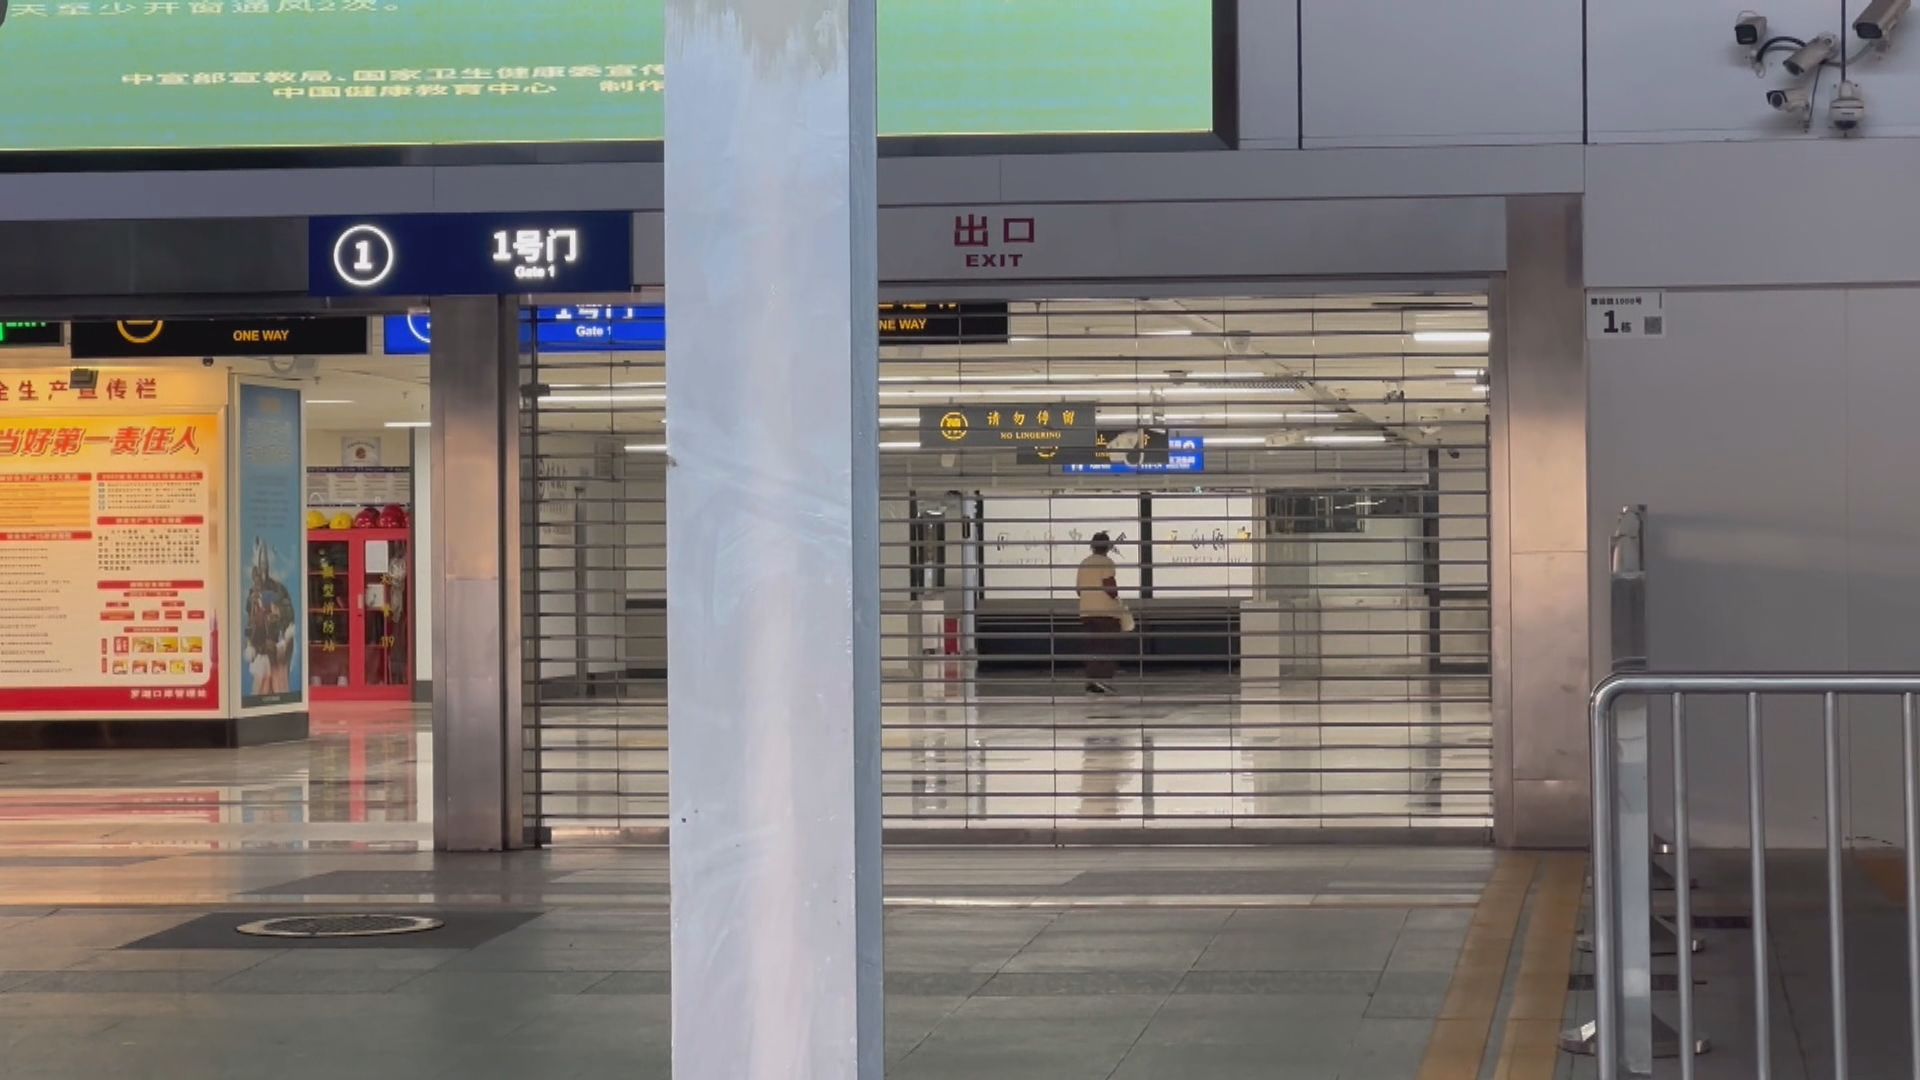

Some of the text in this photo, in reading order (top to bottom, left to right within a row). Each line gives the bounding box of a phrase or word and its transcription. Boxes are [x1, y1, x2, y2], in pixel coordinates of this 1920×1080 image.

[272, 81, 557, 100] 中国健康教育中心
[954, 213, 1035, 247] 出口
[493, 229, 578, 262] 1号门
[965, 253, 1024, 268] EXIT
[514, 264, 556, 279] Gate 1
[576, 325, 604, 338] Gate
[898, 317, 927, 330] WAY
[233, 330, 289, 341] ONE WAY
[987, 410, 1077, 427] 请勿停留
[0, 425, 200, 456] 当好第一责任人
